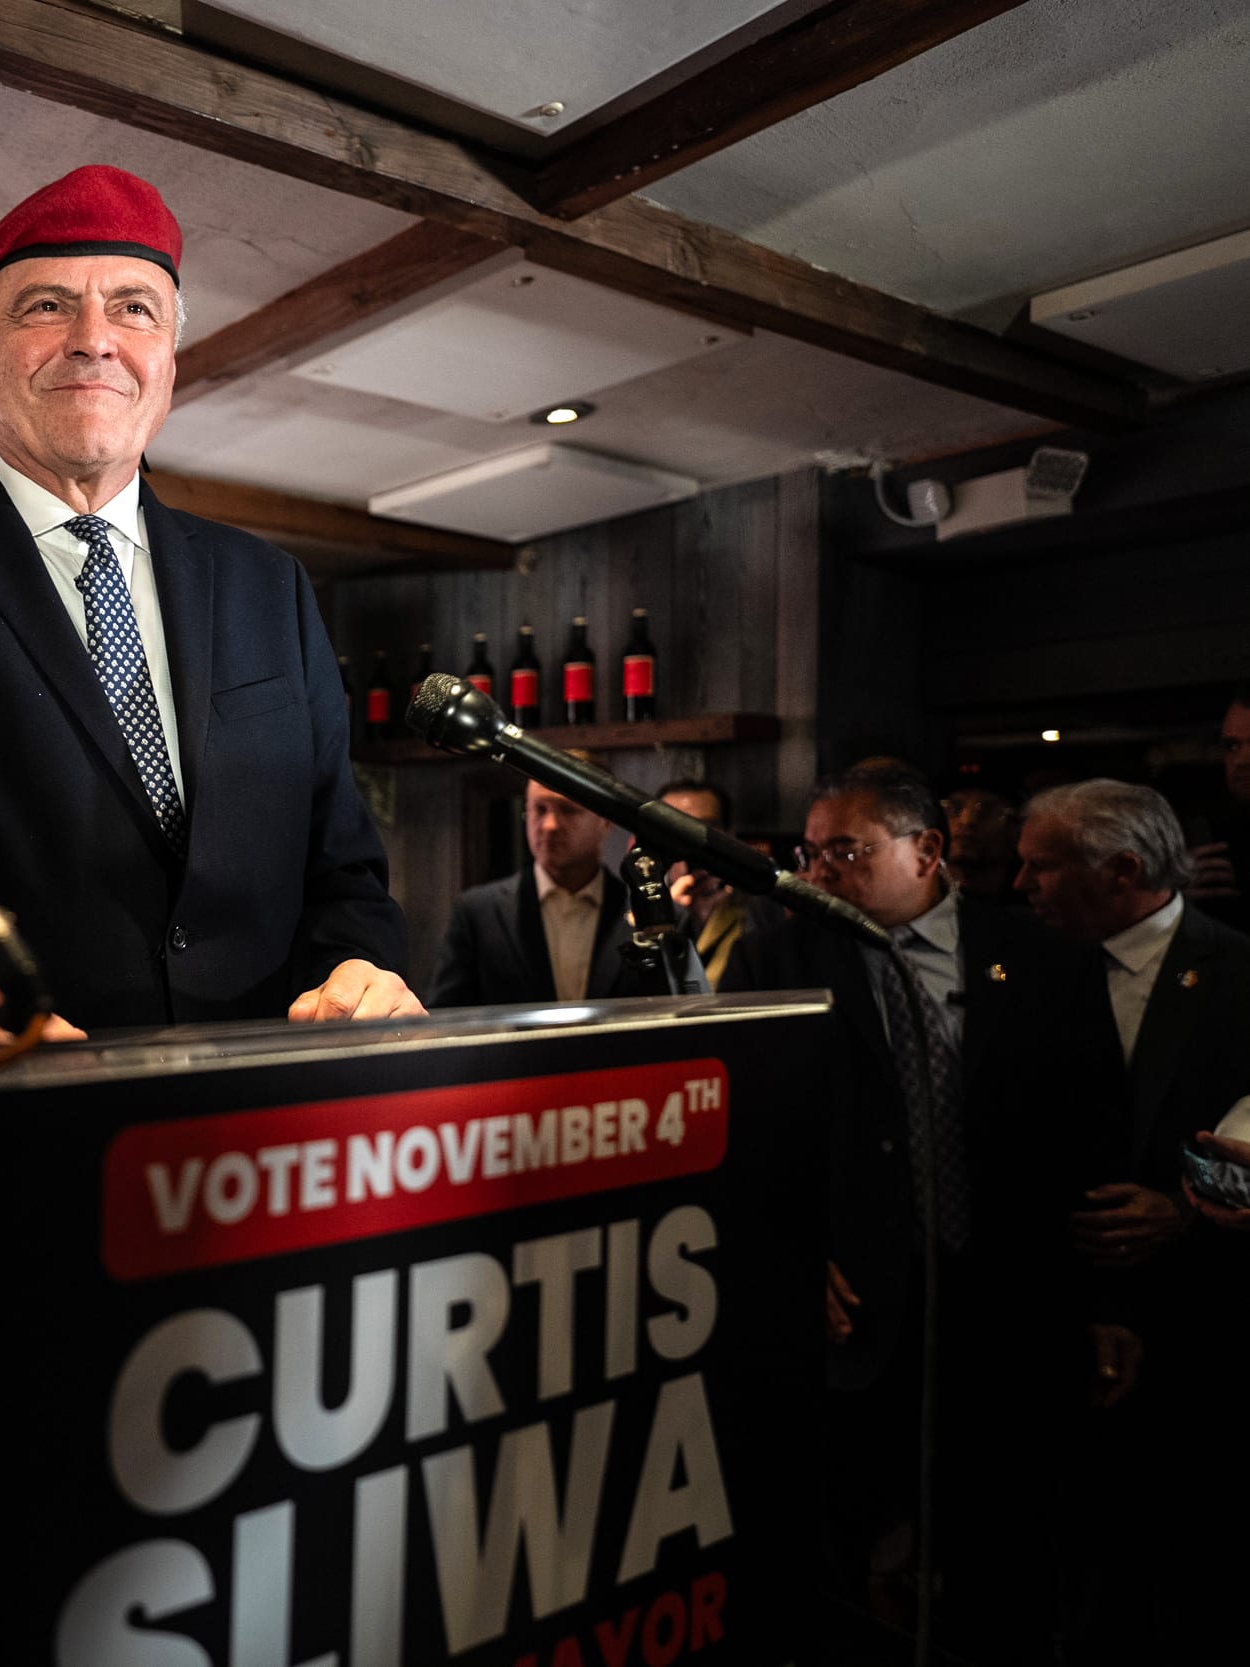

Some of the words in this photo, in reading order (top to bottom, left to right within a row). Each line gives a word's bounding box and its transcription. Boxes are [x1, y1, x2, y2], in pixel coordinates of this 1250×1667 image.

[146, 1138, 337, 1234] VOTE
[345, 1099, 649, 1202] NOVEMBER
[655, 1077, 722, 1146] 4TH
[108, 1204, 719, 1516] CURTIS
[56, 1371, 735, 1667] SLIWA
[513, 1571, 728, 1667] YOR
